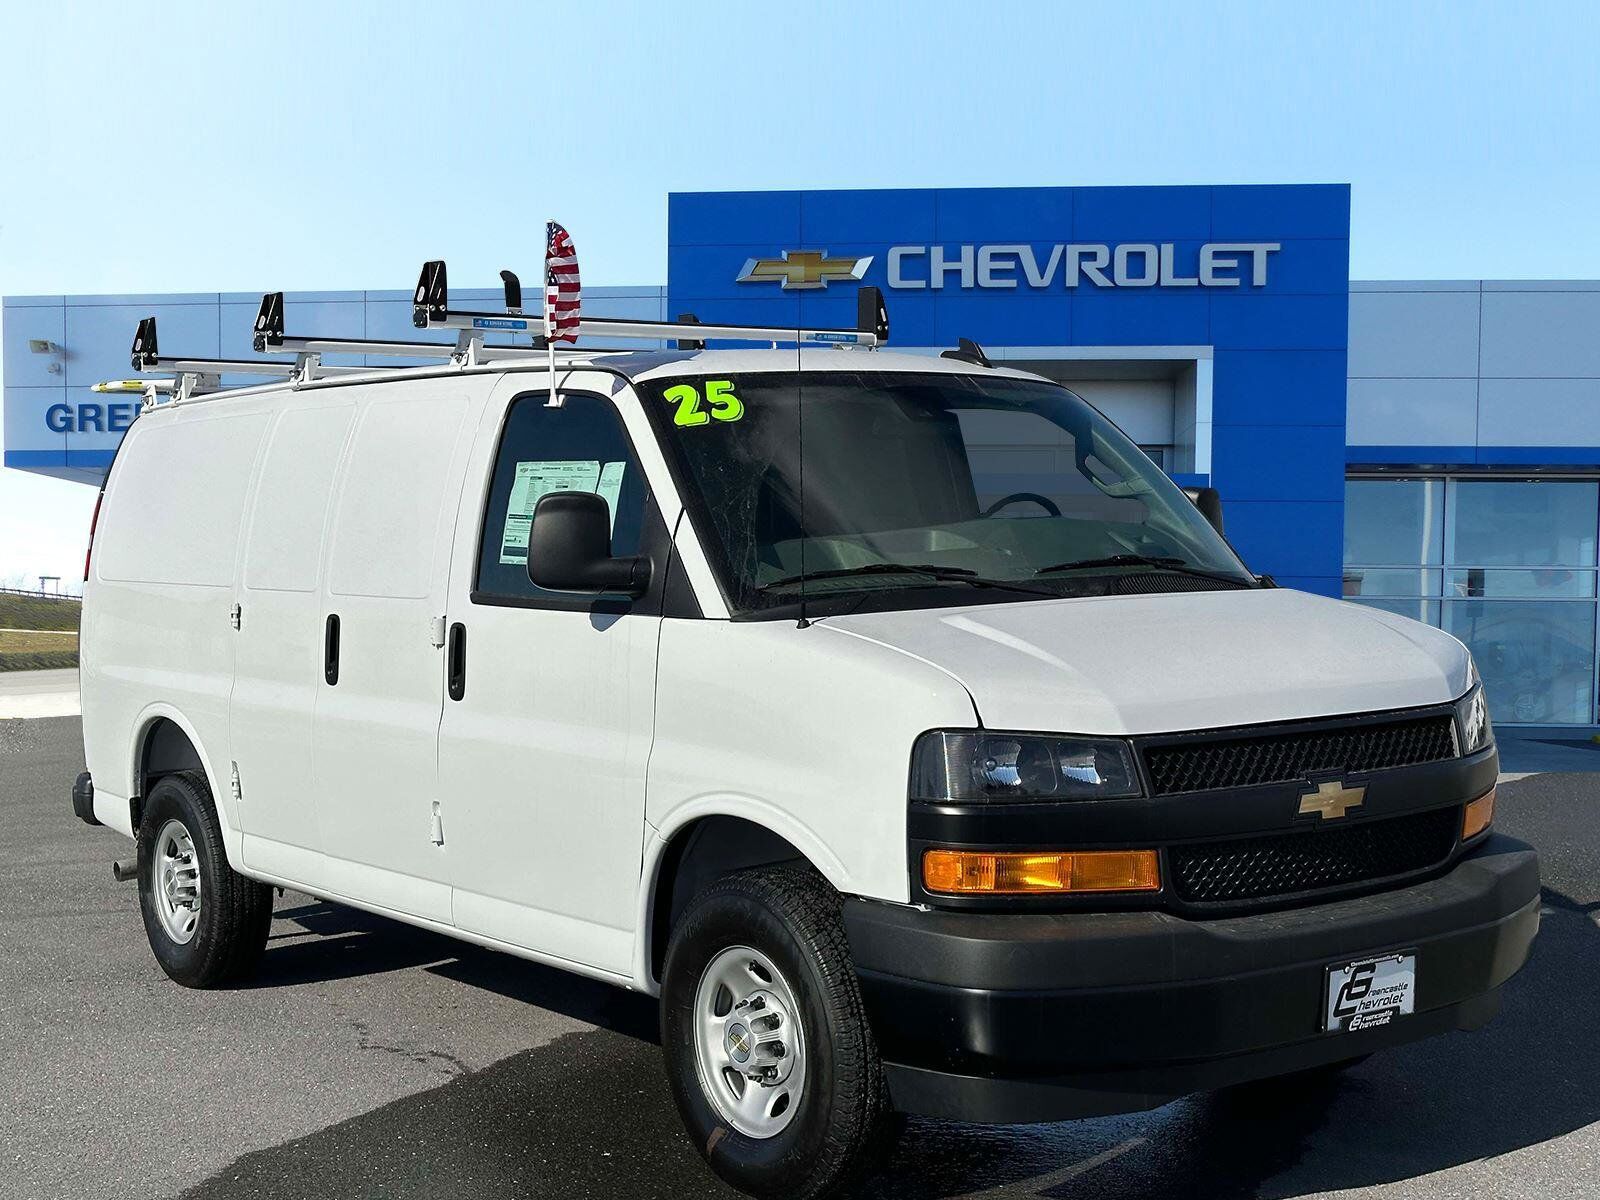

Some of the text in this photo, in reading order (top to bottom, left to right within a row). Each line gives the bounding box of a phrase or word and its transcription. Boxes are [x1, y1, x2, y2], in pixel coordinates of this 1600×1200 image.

[887, 242, 1281, 289] CHEVROLET
[46, 403, 142, 432] GRE
[663, 380, 745, 427] 25
